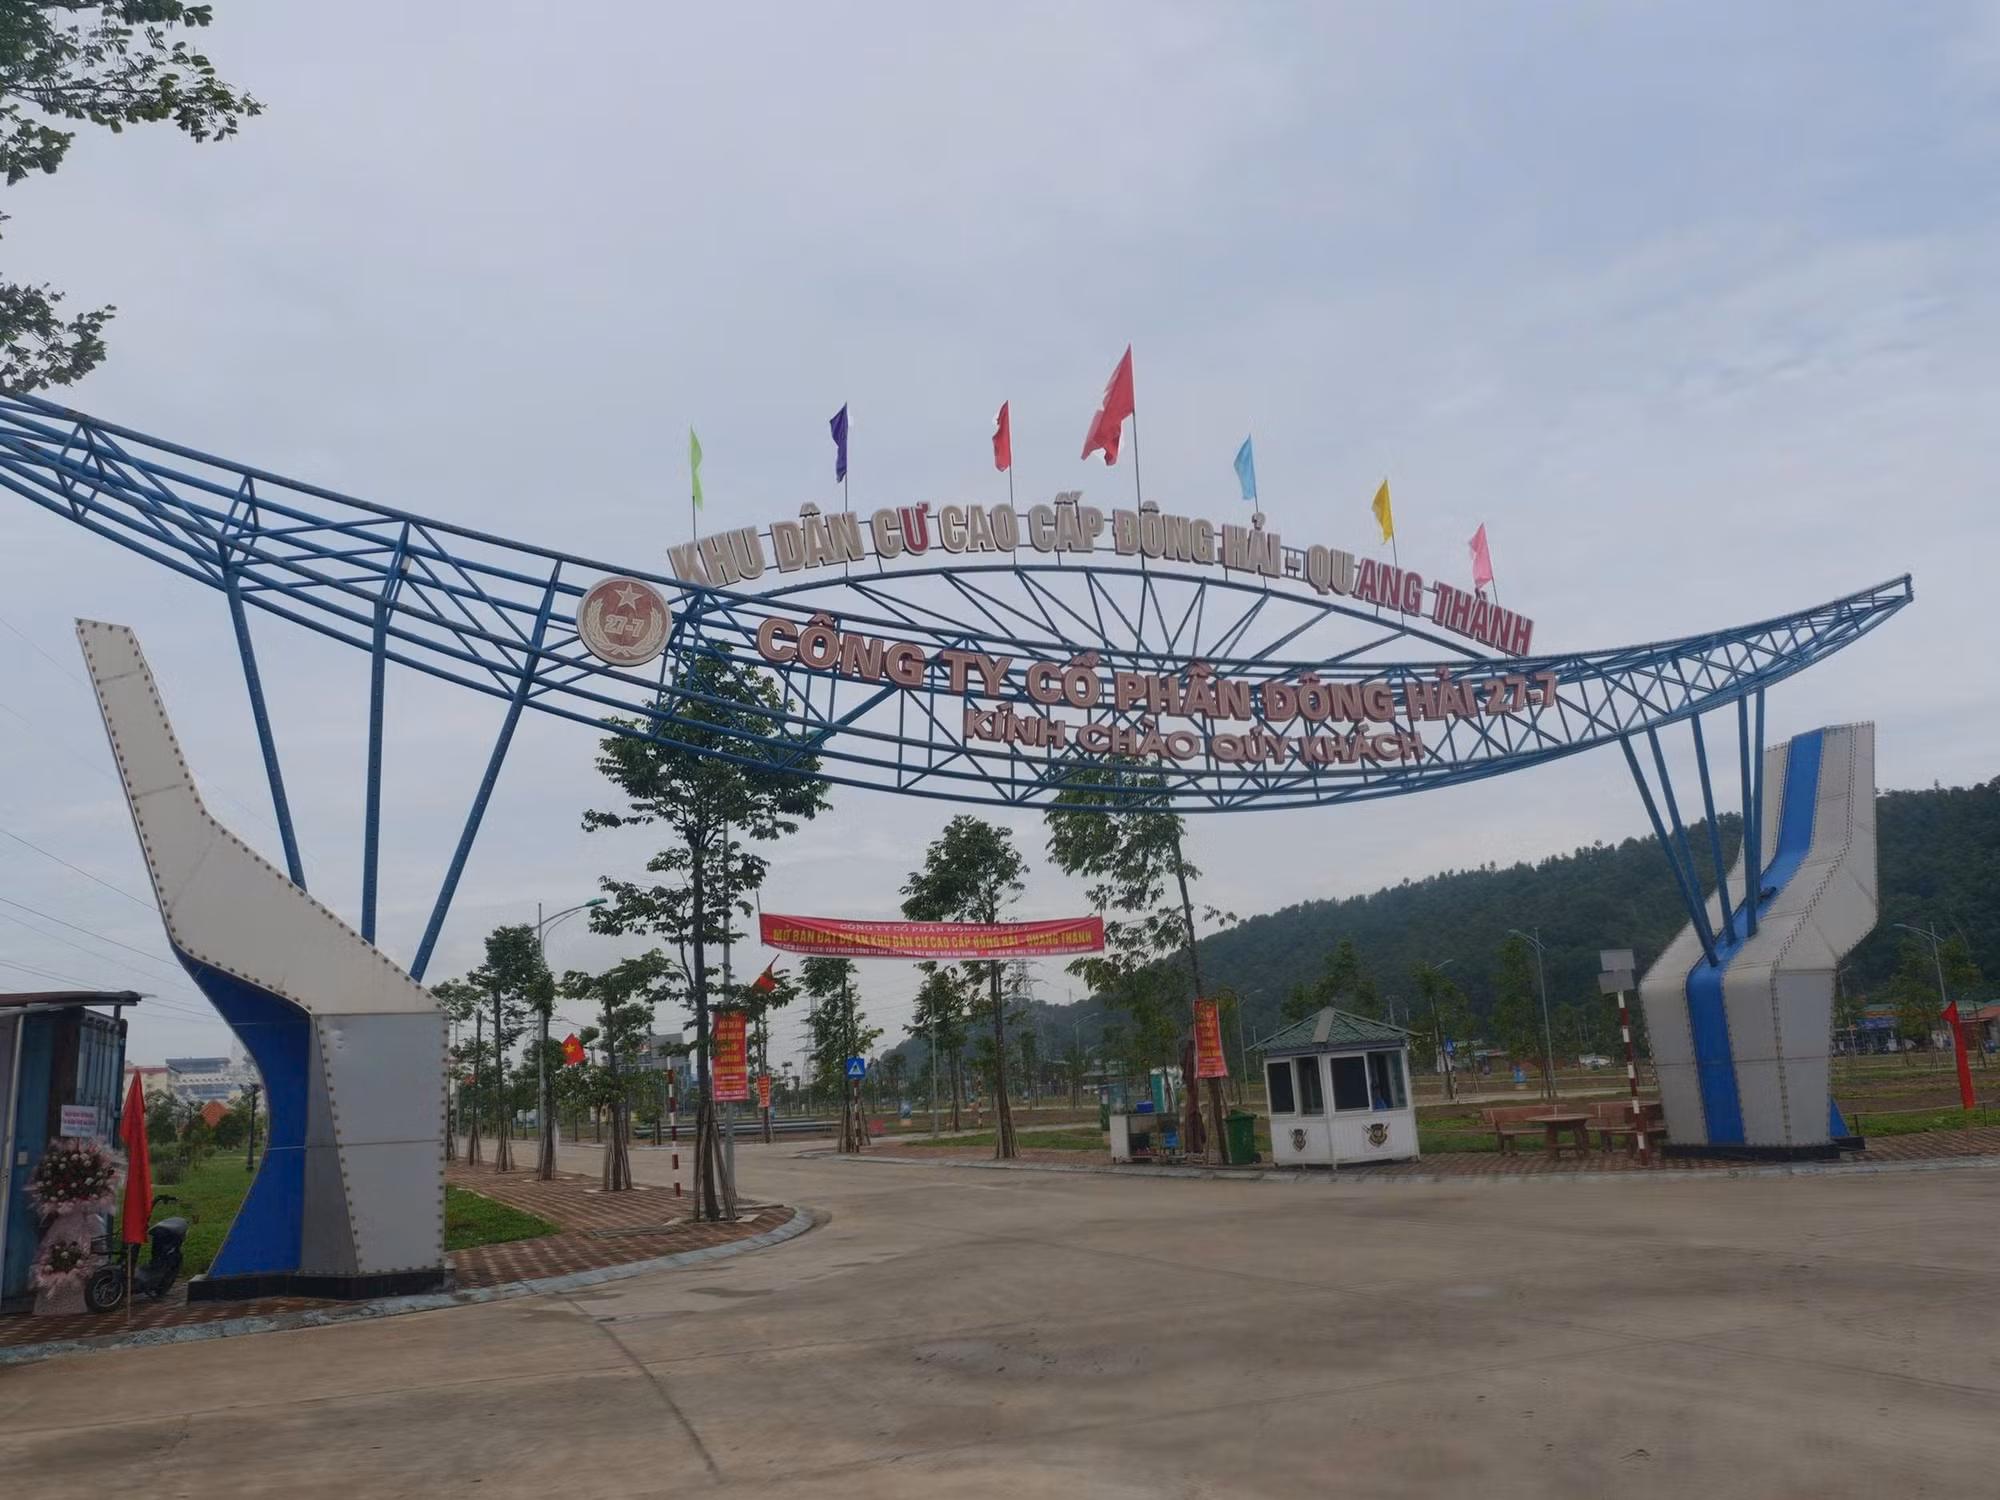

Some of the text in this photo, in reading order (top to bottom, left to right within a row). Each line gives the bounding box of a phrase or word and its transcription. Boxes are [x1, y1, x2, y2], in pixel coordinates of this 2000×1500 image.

[667, 524, 765, 592] KHU
[769, 502, 865, 574] DÂN
[870, 501, 931, 559] CƯ
[938, 503, 1020, 554] CAO
[1029, 491, 1106, 554] CẤP
[1113, 500, 1215, 566] ĐÔNG
[1222, 512, 1282, 579] HẢI
[1306, 544, 1425, 618] QUANG
[1432, 580, 1534, 658] THÀNH
[604, 614, 645, 637] 27-7
[756, 611, 927, 690] CÔNG
[941, 648, 1014, 699] TY
[1025, 650, 1102, 709] CỔ
[1114, 657, 1252, 721] PHẦN
[1262, 672, 1395, 723] ĐÔNG
[1405, 665, 1479, 722] HẢI
[965, 701, 1066, 750] KÍNH
[1076, 717, 1200, 760] CHÀO
[1298, 724, 1426, 765] KHÁCH
[930, 936, 949, 949] CAO
